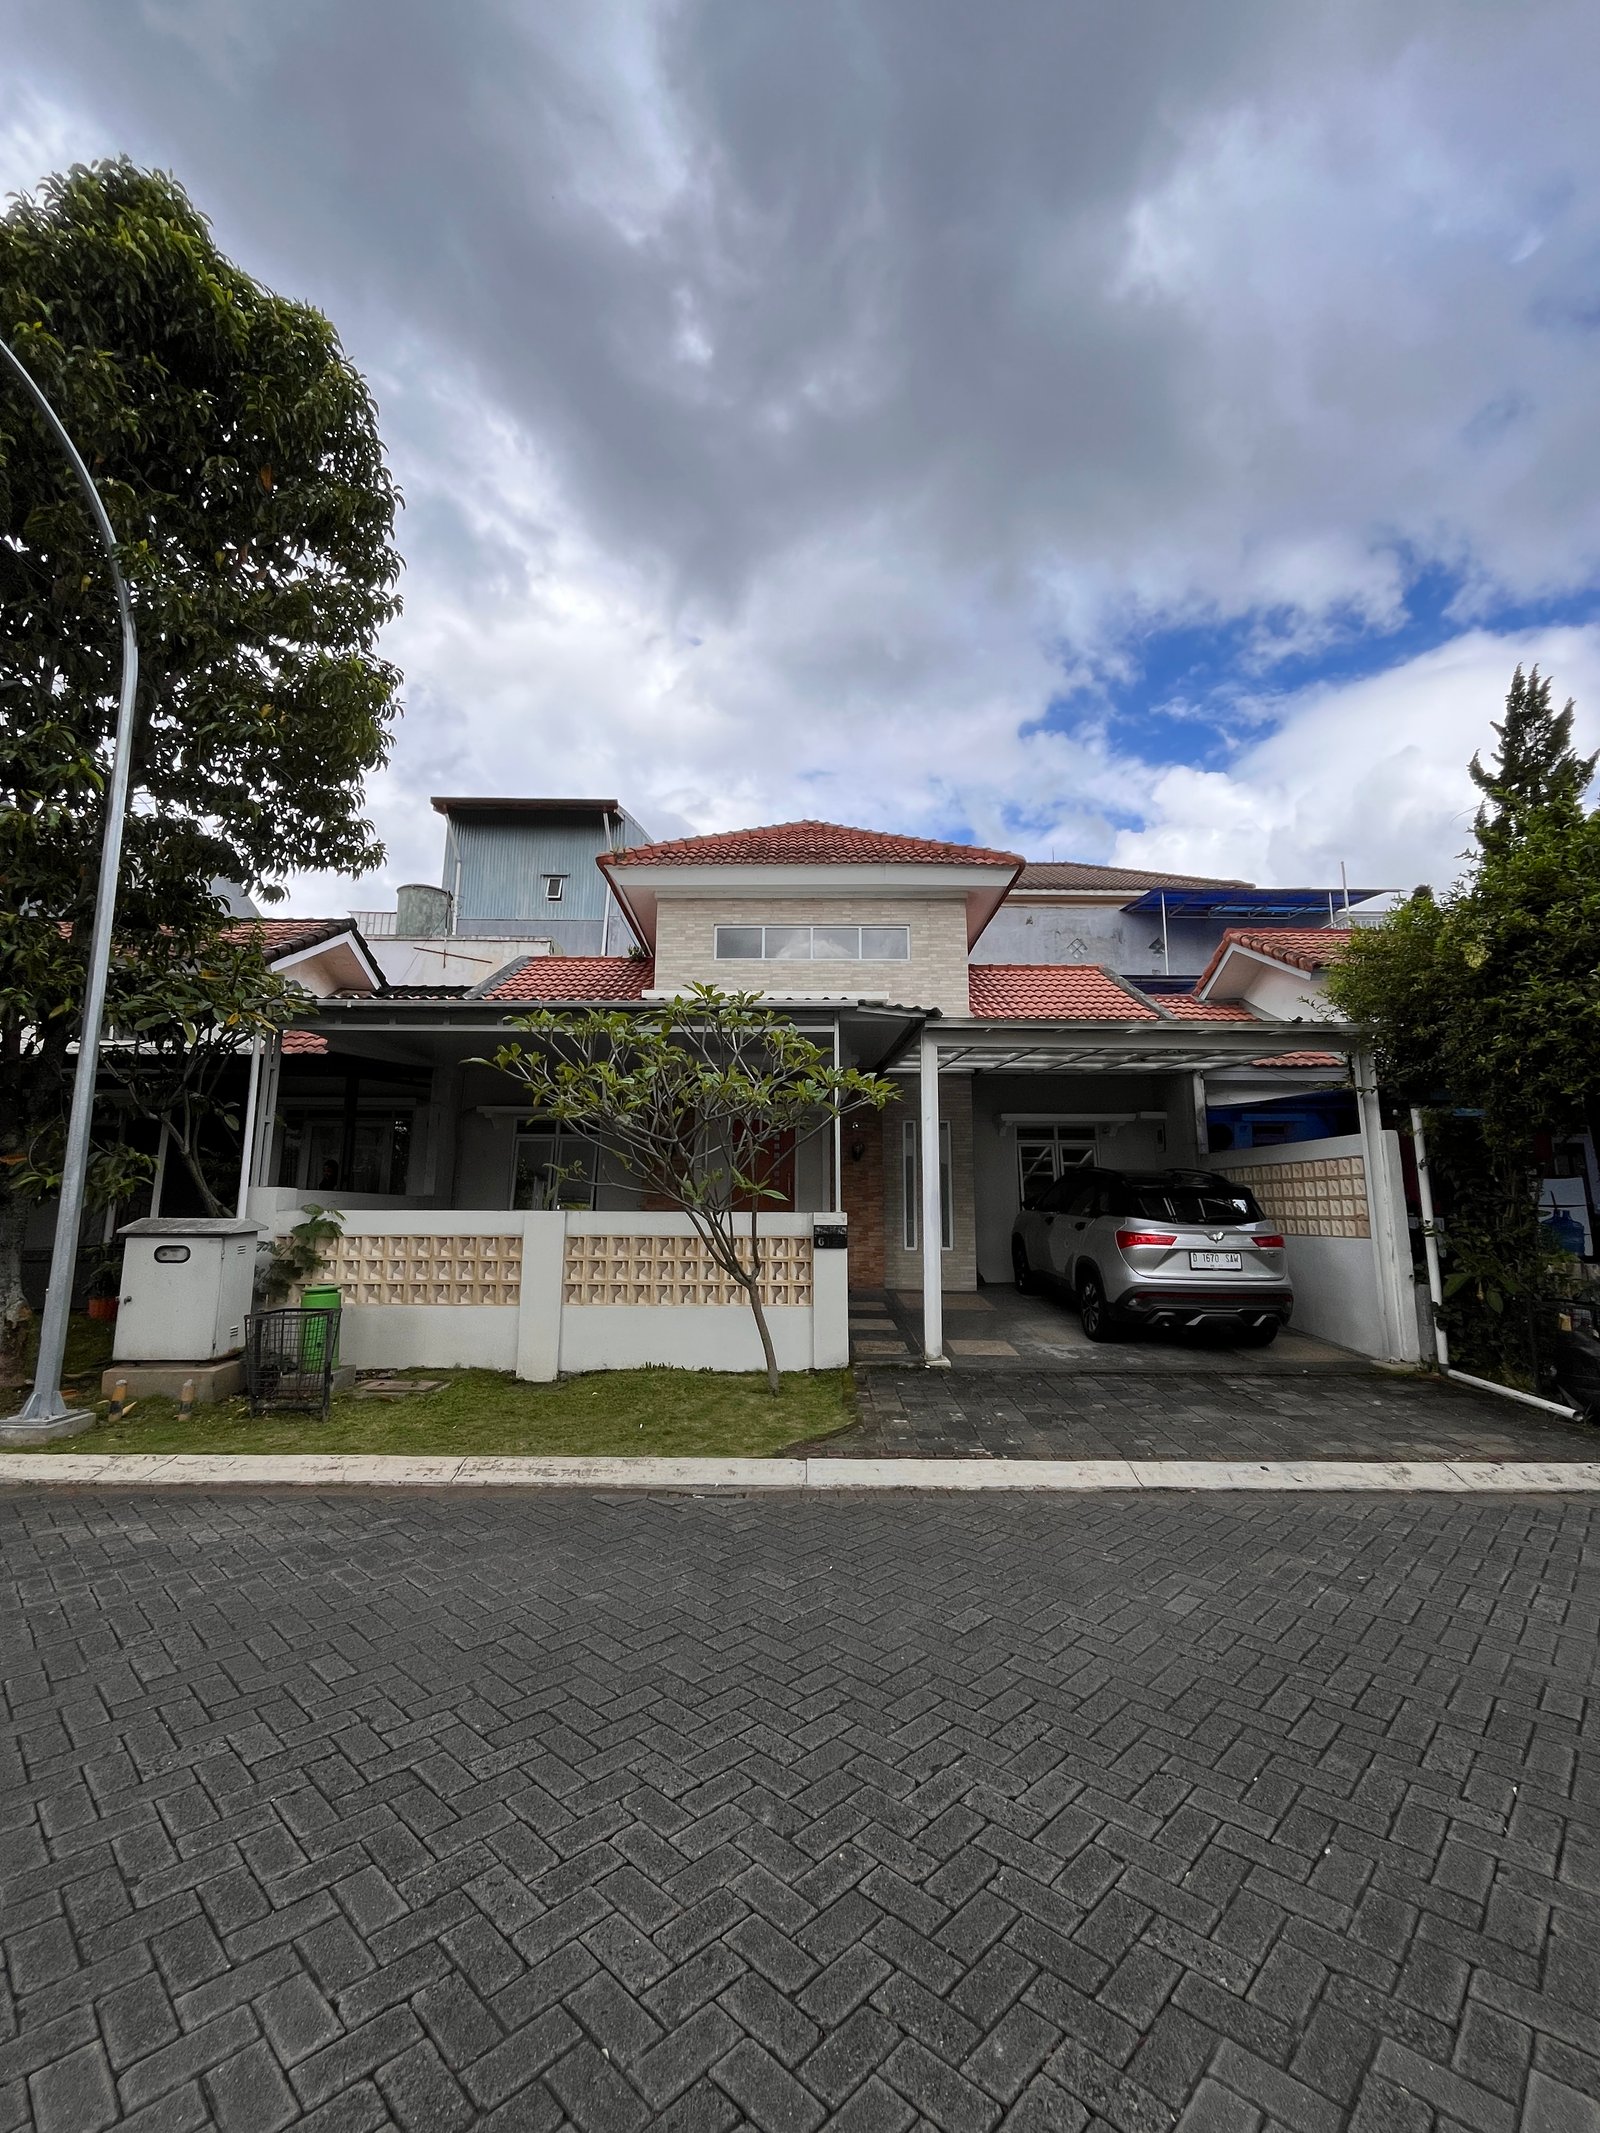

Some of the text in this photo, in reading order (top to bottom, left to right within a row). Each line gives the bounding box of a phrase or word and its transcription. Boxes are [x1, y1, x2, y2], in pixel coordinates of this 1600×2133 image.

[1193, 1253, 1239, 1262] D 1670 SAW
